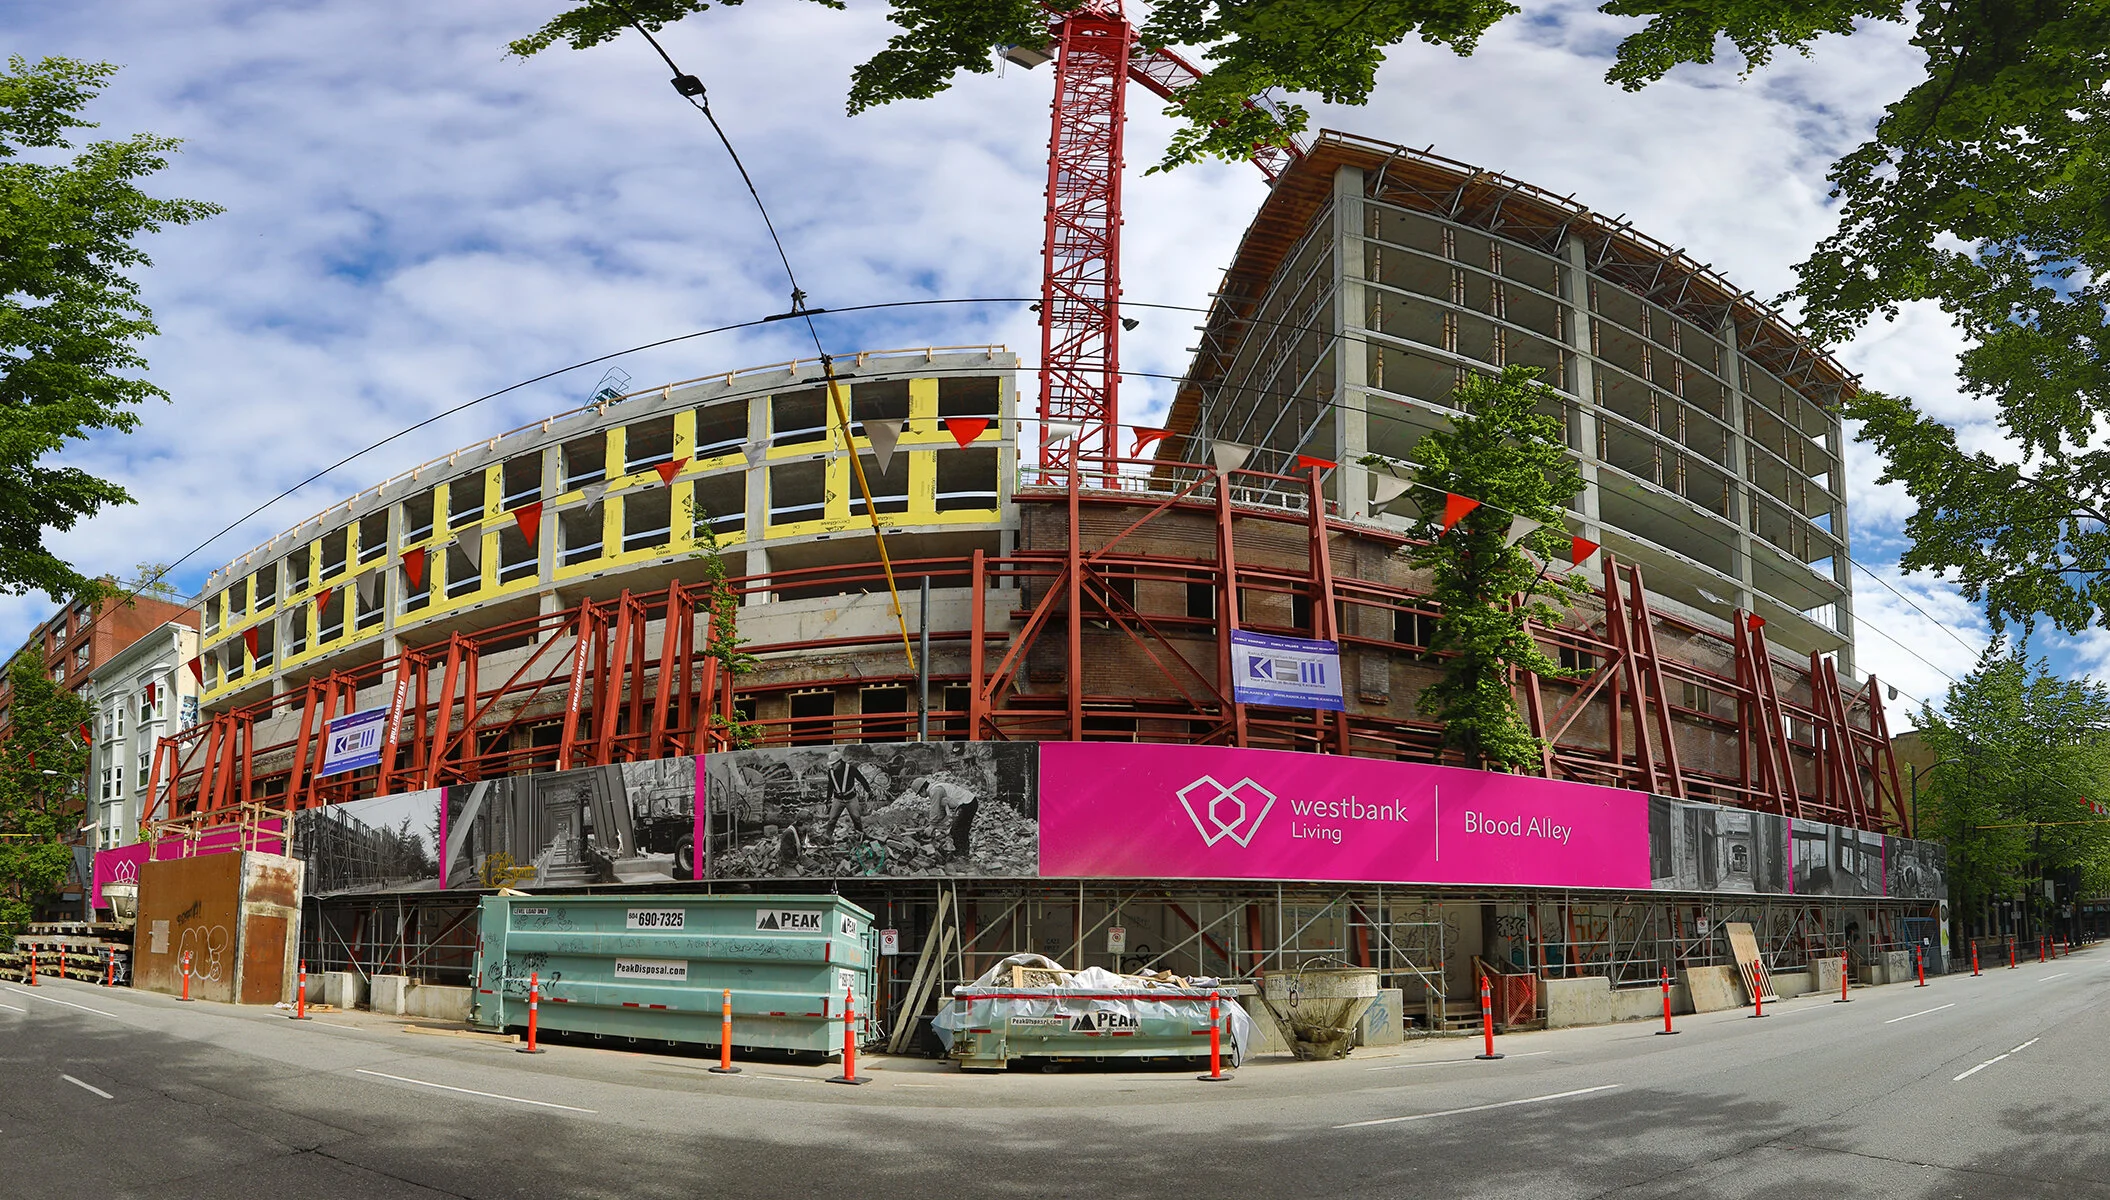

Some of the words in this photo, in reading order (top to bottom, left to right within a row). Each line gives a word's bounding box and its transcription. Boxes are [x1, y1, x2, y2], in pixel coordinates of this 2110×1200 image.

[1291, 796, 1408, 822] westbank
[1292, 821, 1342, 844] Living
[1465, 810, 1521, 836] Blood
[1526, 817, 1572, 845] Alley
[781, 912, 820, 927] PEAK
[616, 963, 686, 976] PeakDisposal.com
